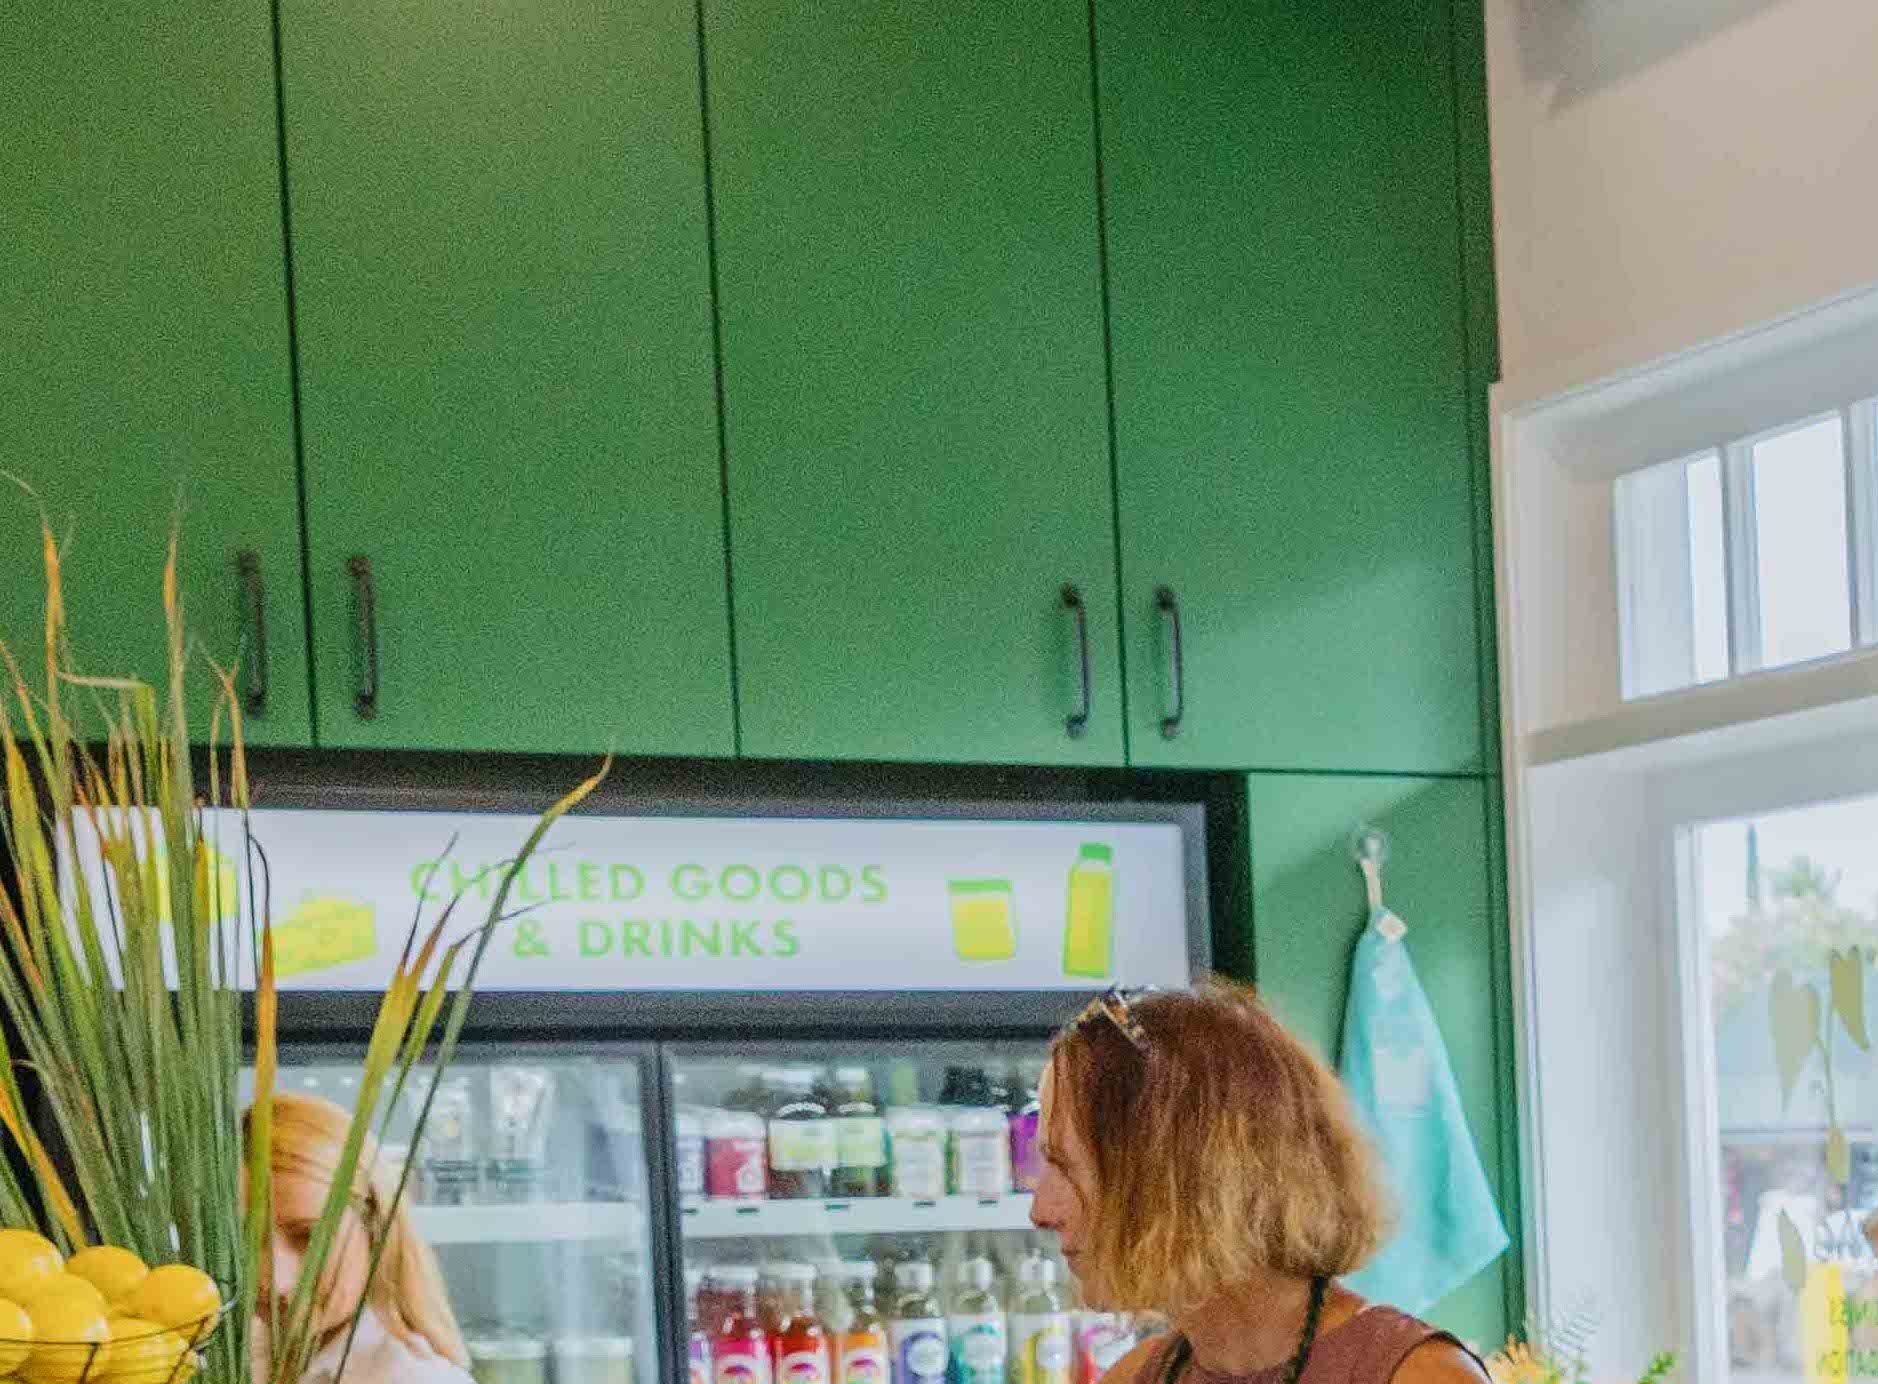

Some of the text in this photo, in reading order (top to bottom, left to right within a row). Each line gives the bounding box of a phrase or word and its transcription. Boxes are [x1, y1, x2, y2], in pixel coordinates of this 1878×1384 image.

[410, 862, 889, 902] CHLLED GOODS
[512, 918, 799, 959] & DRINKS
